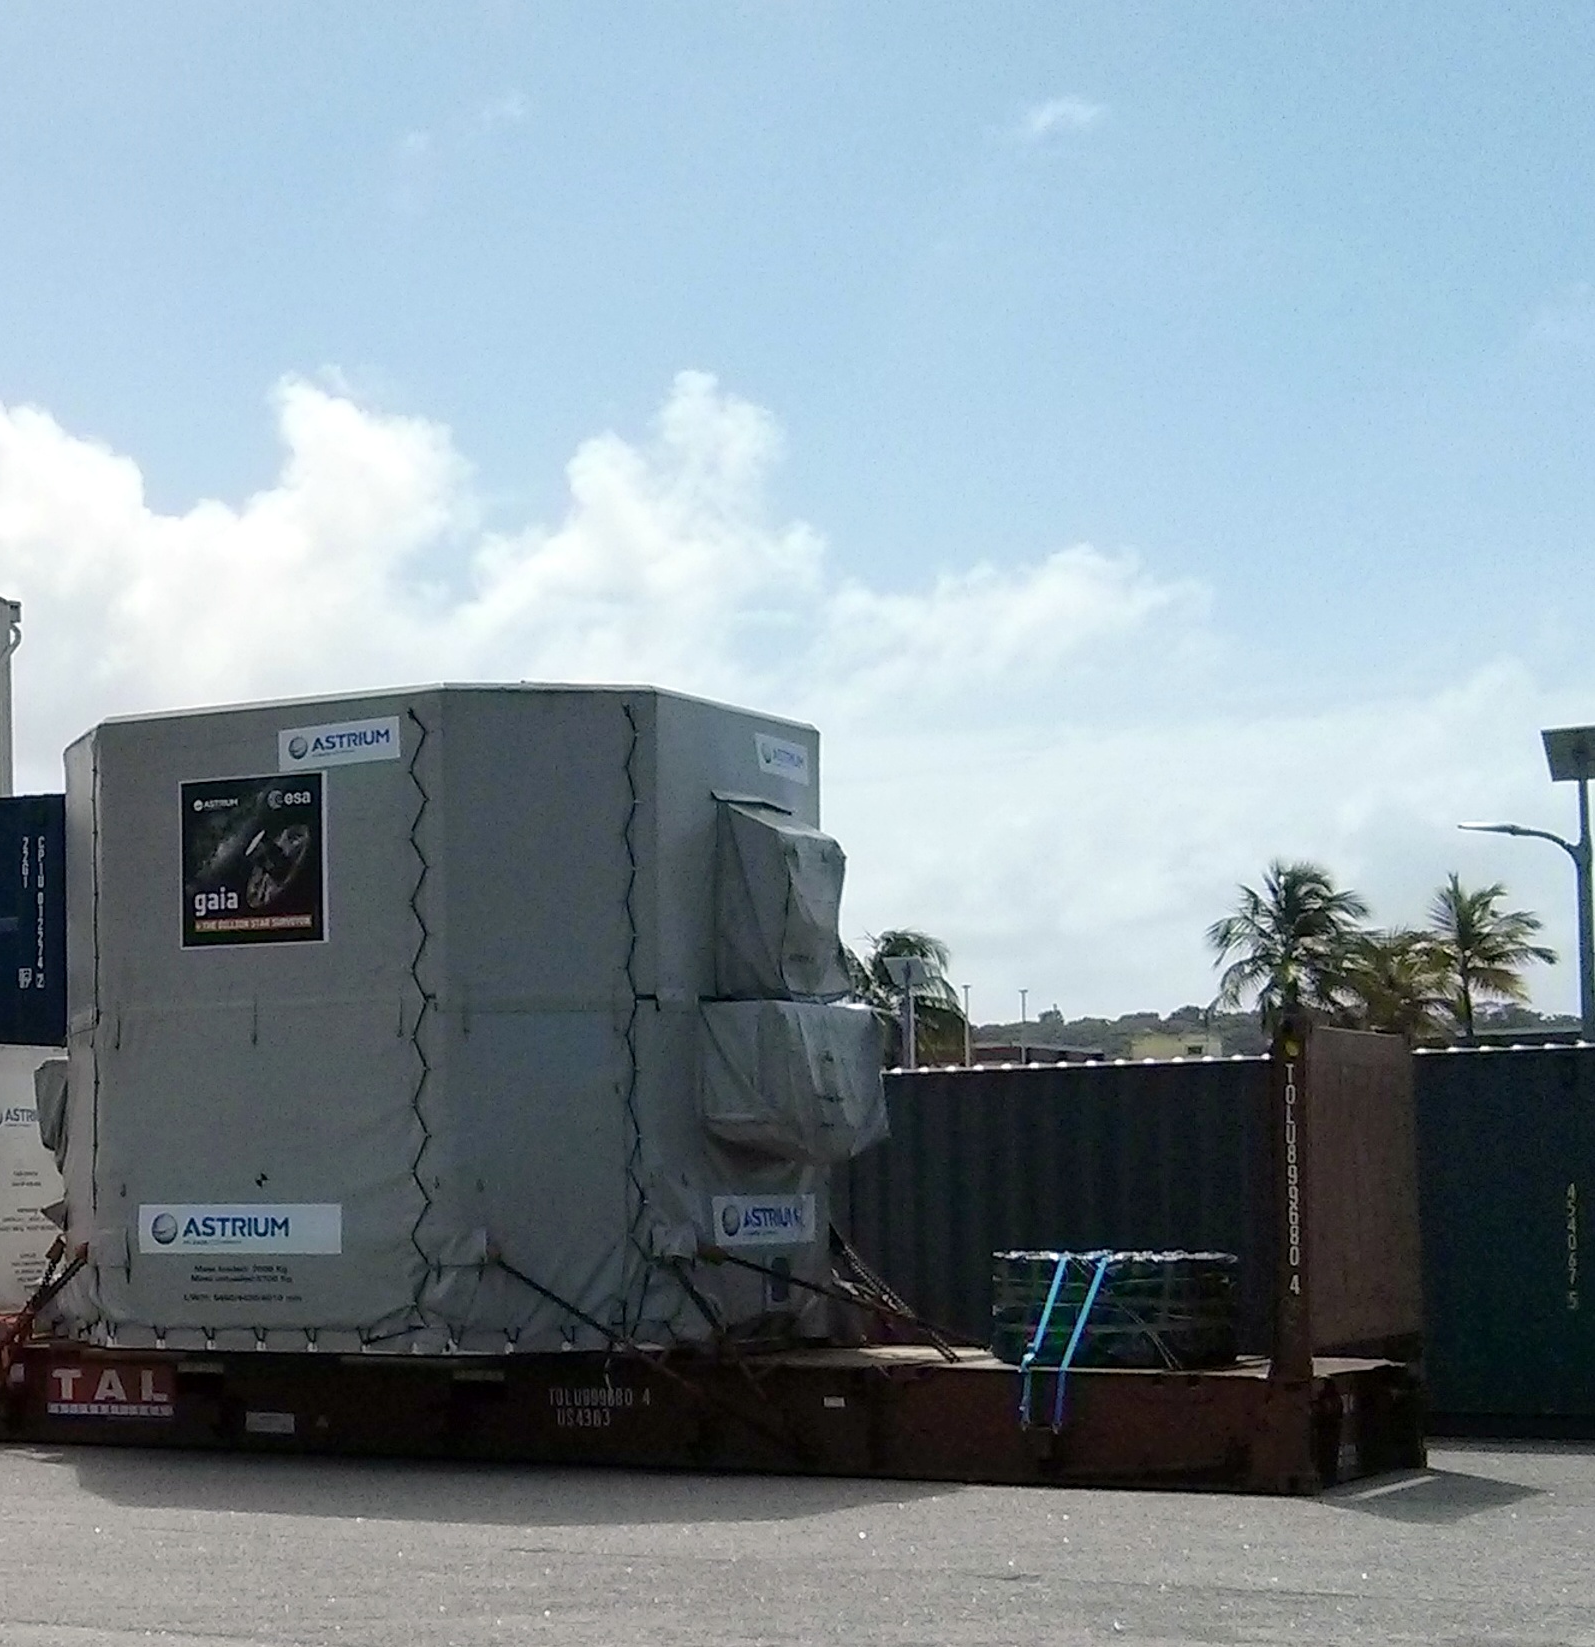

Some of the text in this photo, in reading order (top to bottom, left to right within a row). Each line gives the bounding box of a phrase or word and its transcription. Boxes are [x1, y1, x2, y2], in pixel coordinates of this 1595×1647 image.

[312, 729, 390, 752] ASTRIUM
[284, 791, 312, 805] esa
[194, 886, 239, 916] gaia
[5, 1108, 36, 1122] ASTR
[1285, 1063, 1300, 1295] TOLU899680 4
[183, 1216, 290, 1237] ASTRIUM
[52, 1368, 169, 1402] TAL
